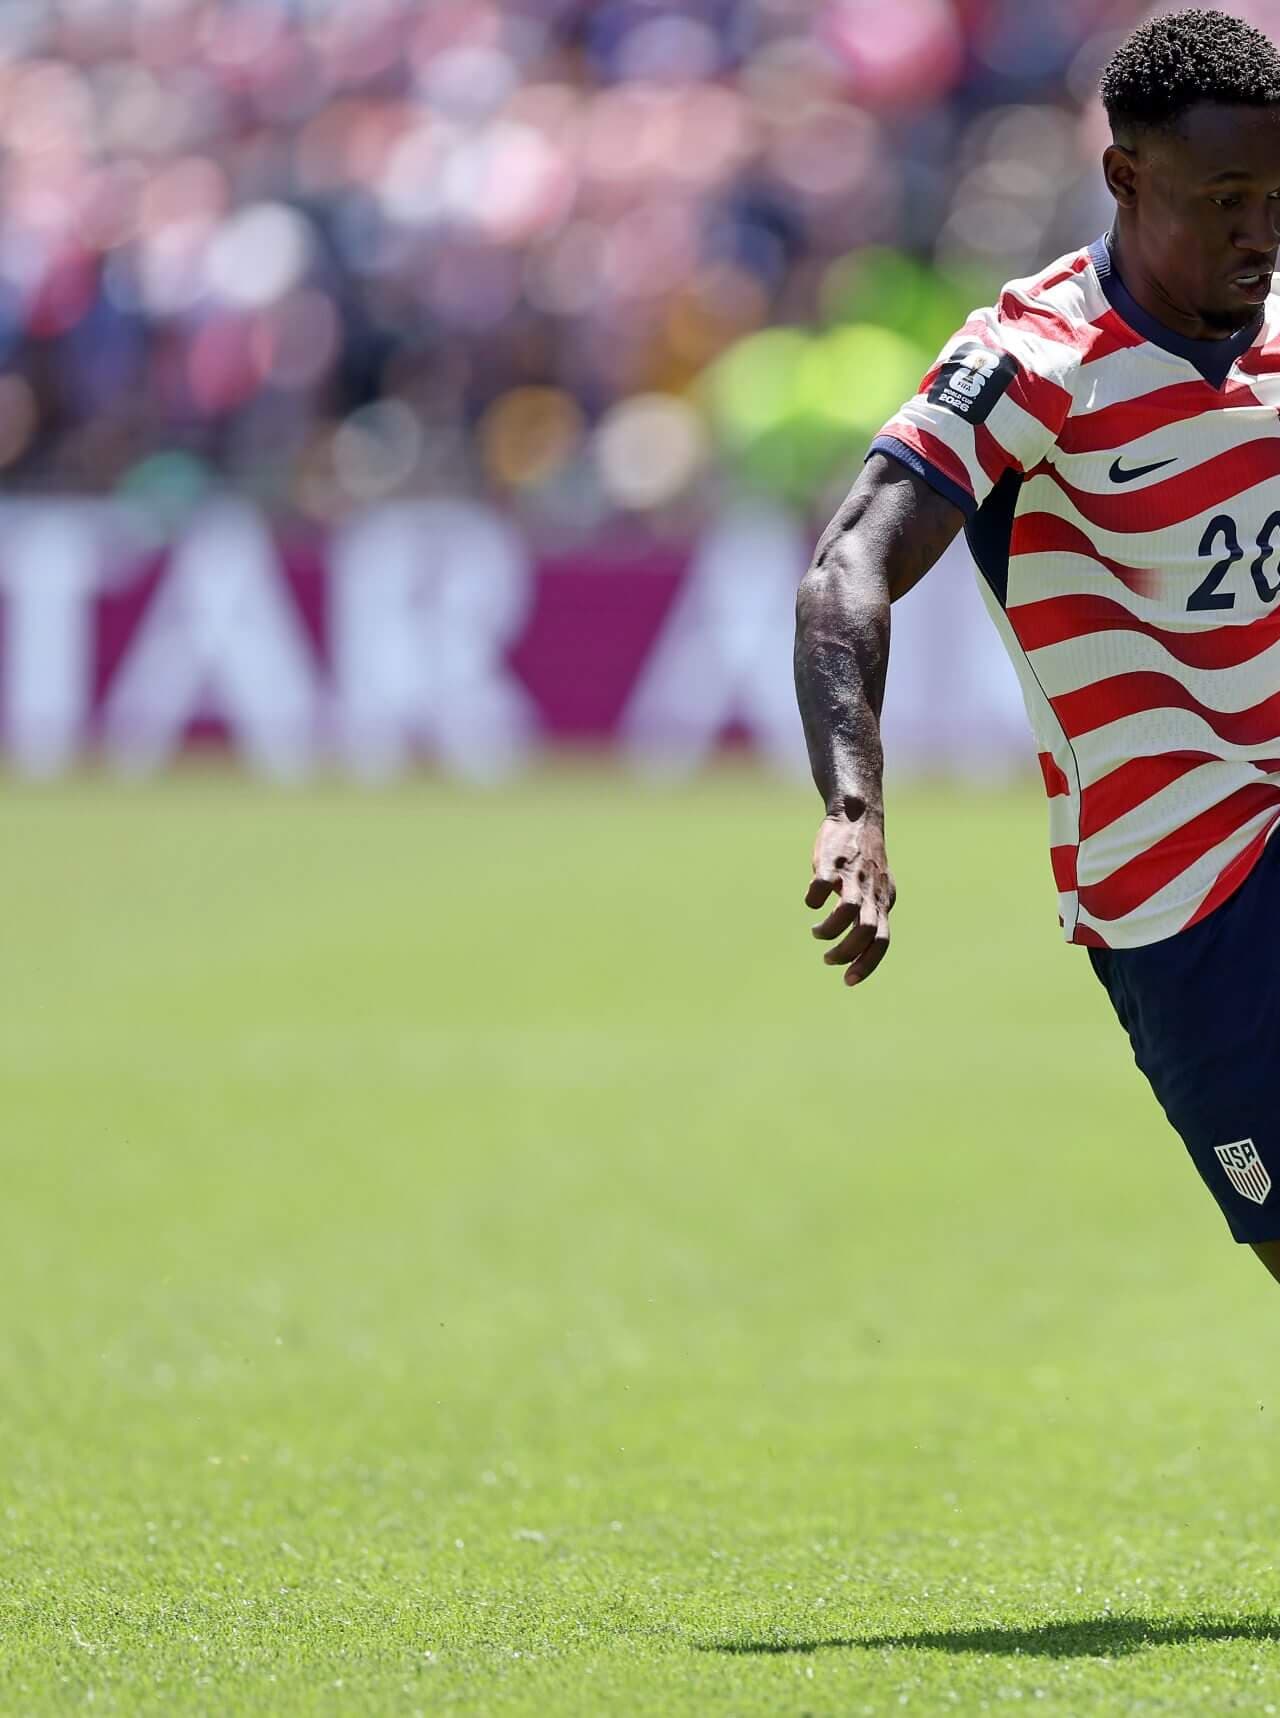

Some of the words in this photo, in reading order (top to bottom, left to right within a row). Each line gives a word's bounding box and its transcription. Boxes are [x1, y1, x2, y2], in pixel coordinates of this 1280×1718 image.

[957, 381, 971, 391] FIFA
[938, 393, 970, 412] 2026
[943, 388, 962, 400] WORLD
[960, 395, 974, 405] CUP
[1217, 1142, 1255, 1170] USA
